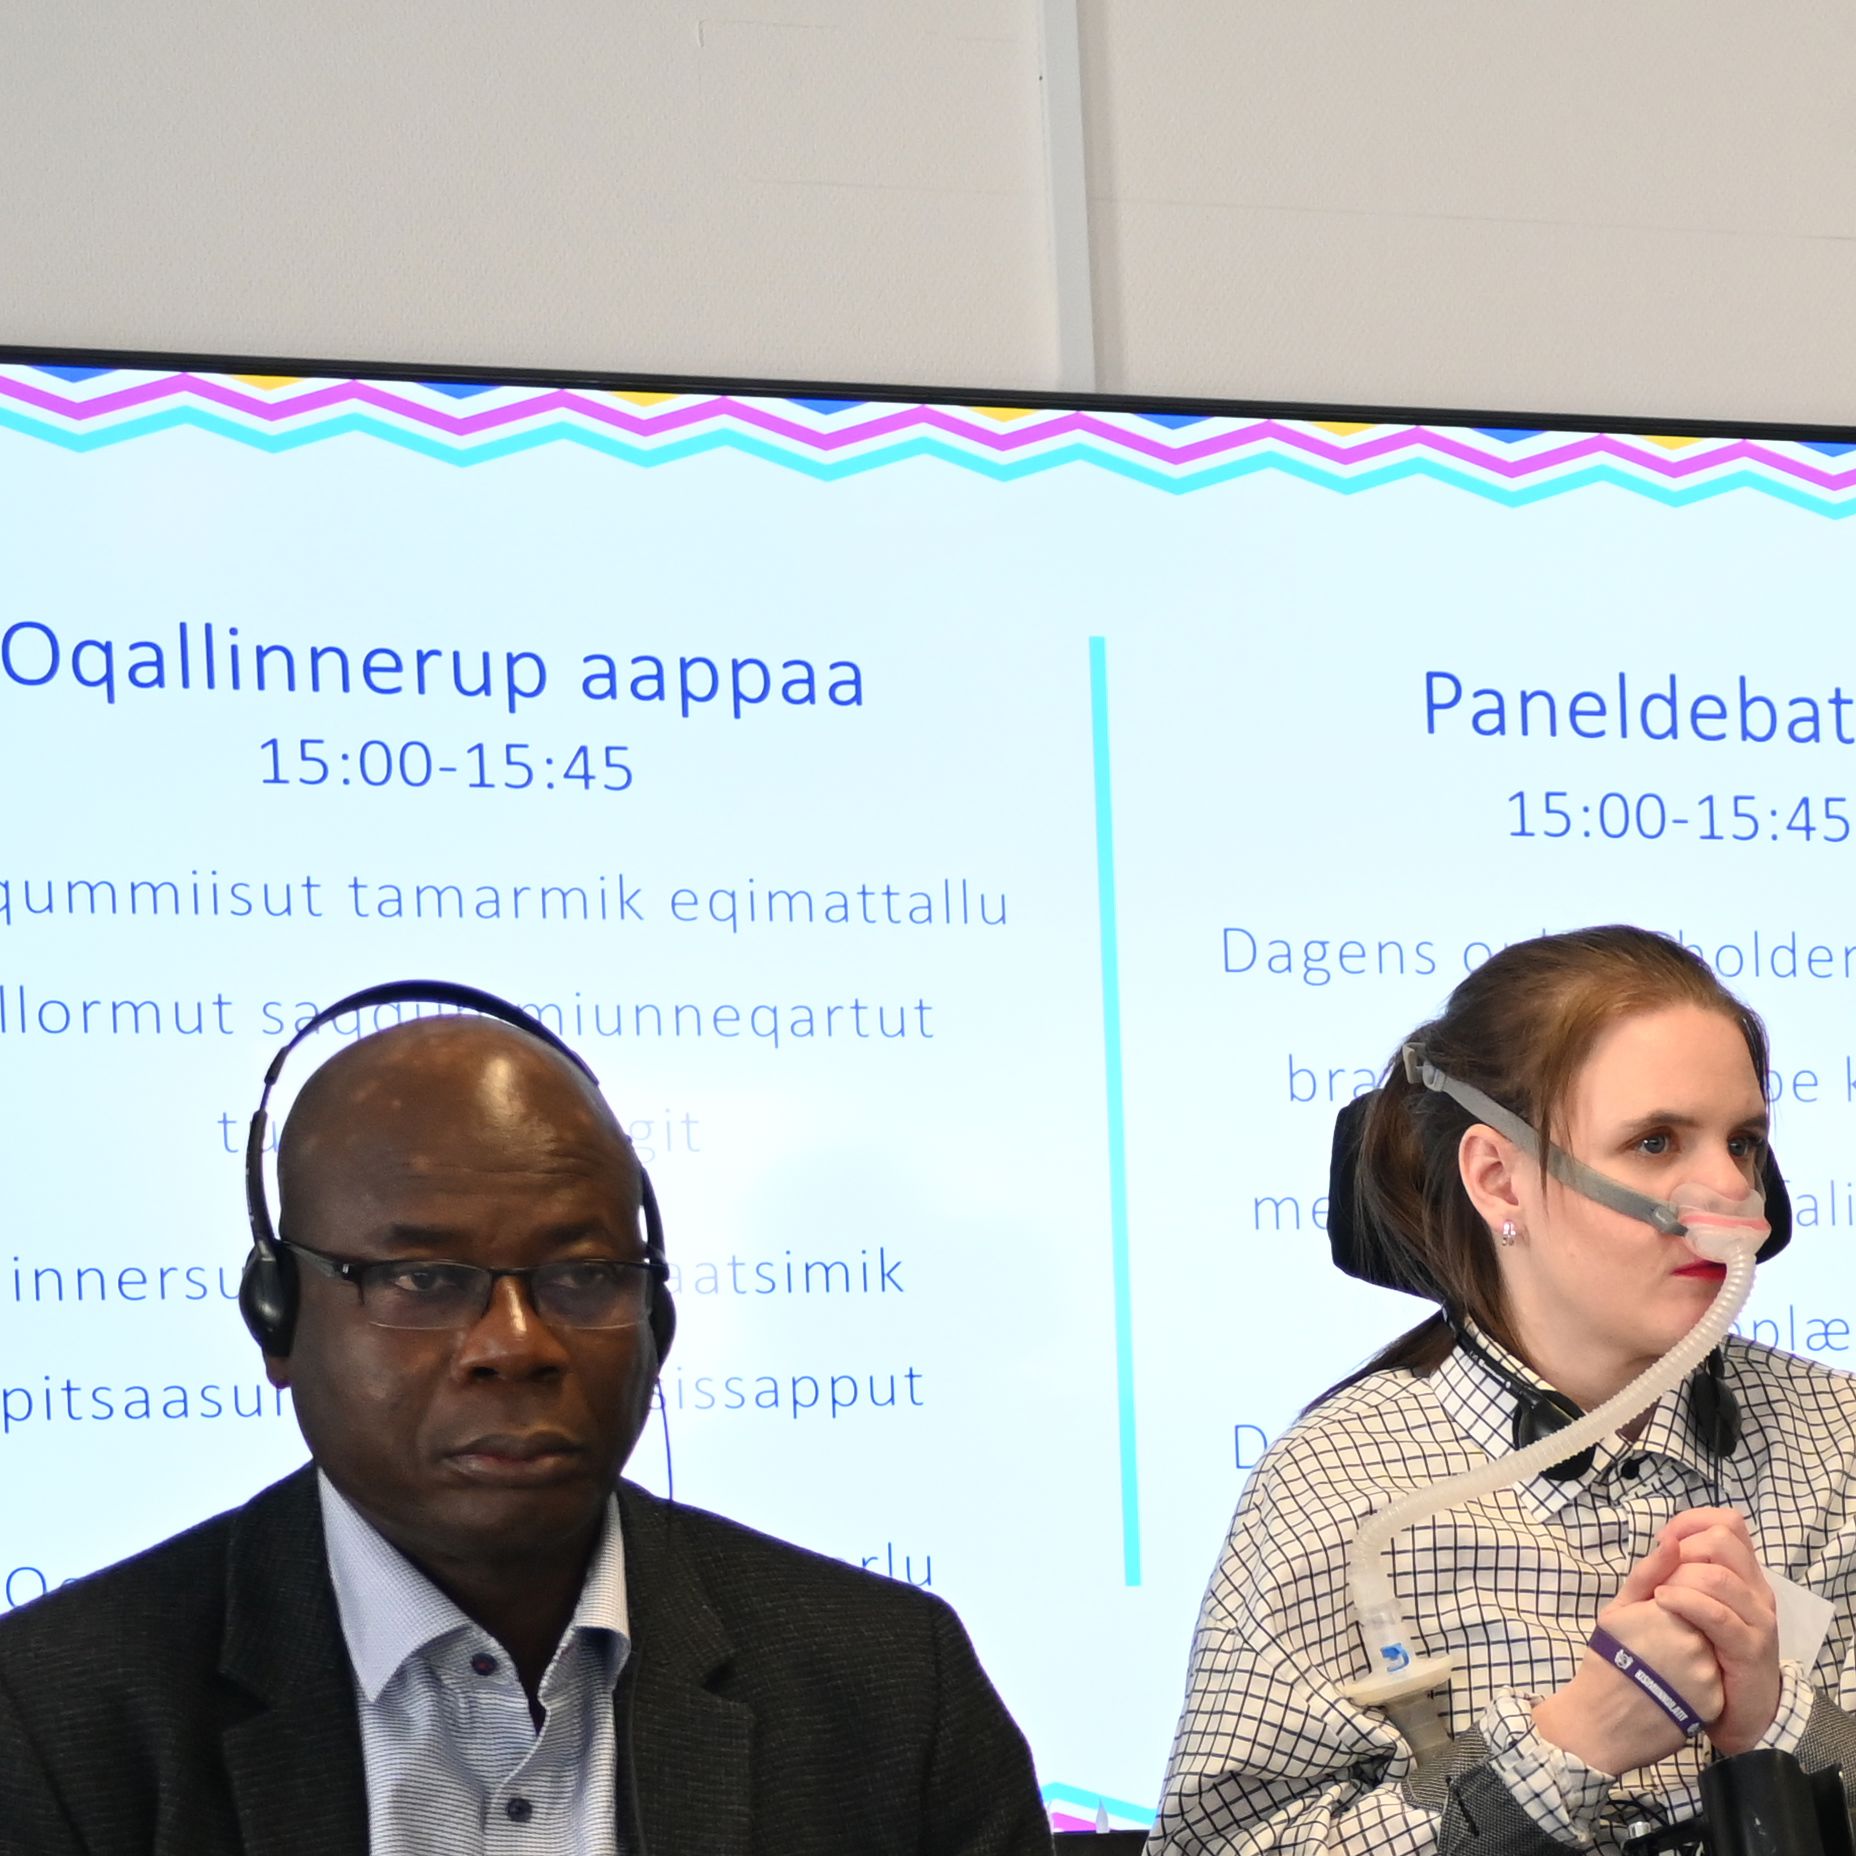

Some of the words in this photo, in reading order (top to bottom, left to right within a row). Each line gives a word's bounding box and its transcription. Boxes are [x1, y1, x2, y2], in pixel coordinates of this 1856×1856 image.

[0, 621, 549, 716] Oqallinnerup
[582, 653, 865, 722] aappaa
[1425, 671, 1856, 747] Paneldebat
[261, 738, 635, 793] 15:00-15:45
[1508, 790, 1852, 845] 15:00-15:45
[348, 873, 646, 922] tamarmik
[671, 878, 1008, 936] eqimattallu
[1223, 927, 1438, 988] Dagens
